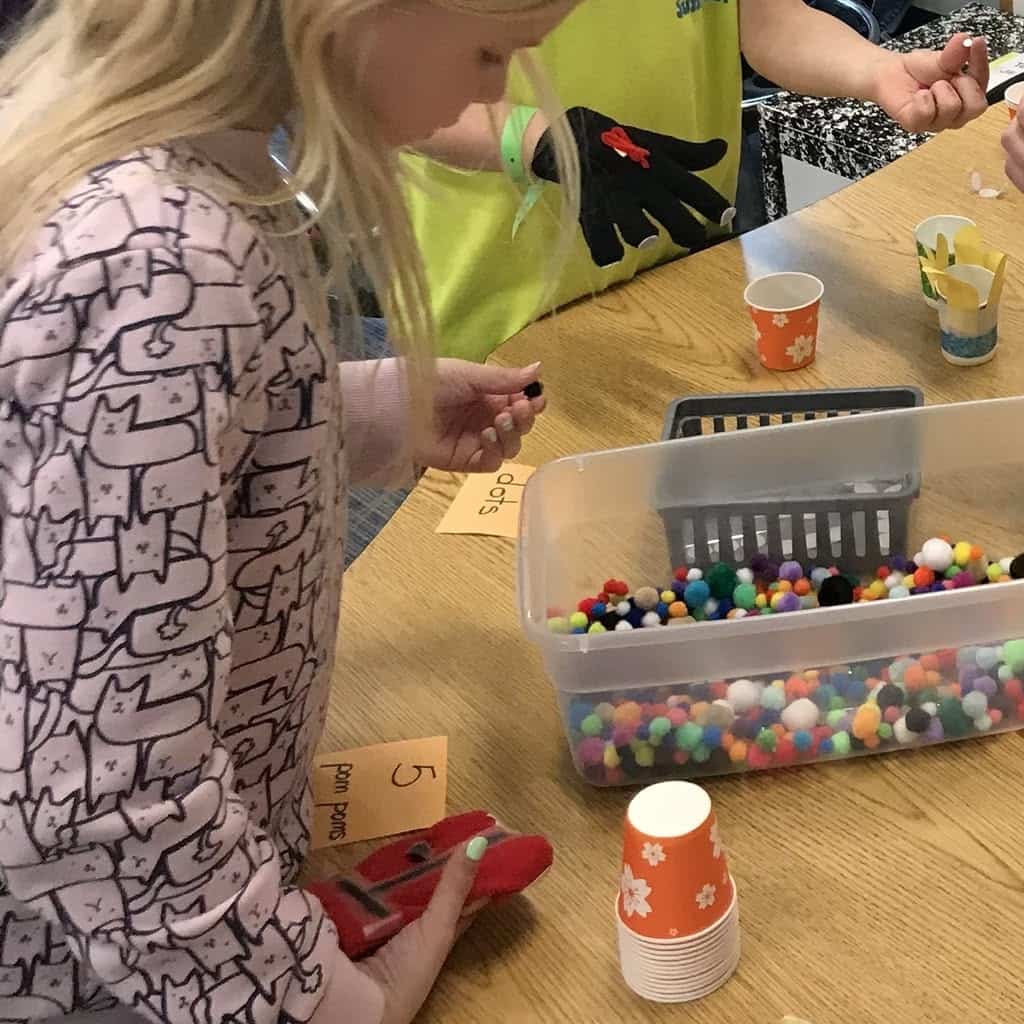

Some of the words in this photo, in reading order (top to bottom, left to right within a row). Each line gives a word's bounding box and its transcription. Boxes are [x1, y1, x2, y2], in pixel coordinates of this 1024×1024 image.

[478, 472, 527, 516] dots
[319, 762, 353, 794] pom
[391, 762, 436, 788] 5
[314, 801, 349, 842] poms
